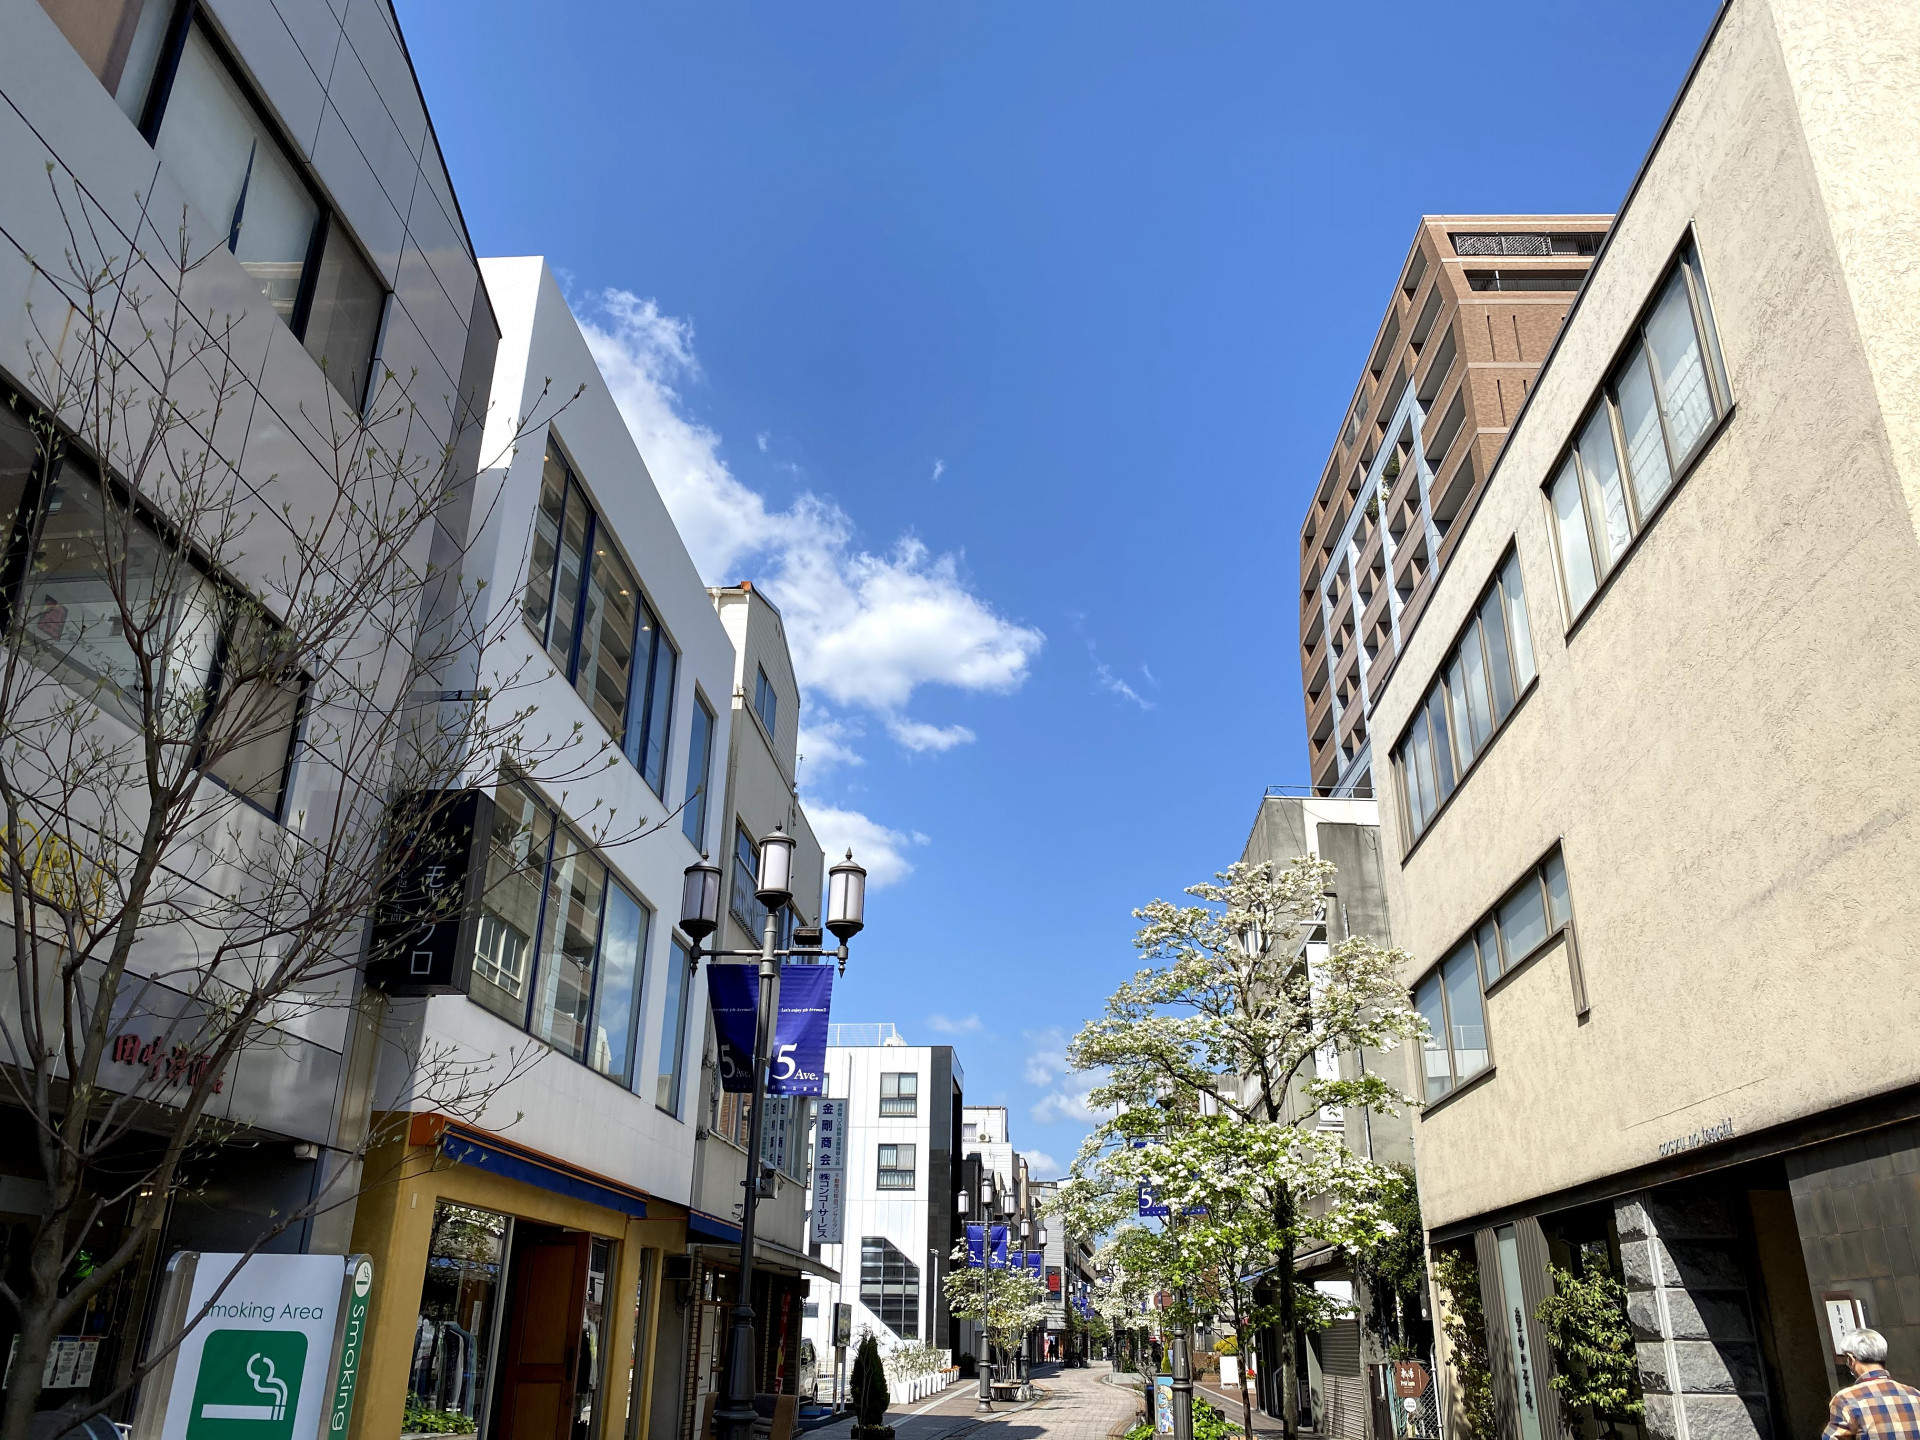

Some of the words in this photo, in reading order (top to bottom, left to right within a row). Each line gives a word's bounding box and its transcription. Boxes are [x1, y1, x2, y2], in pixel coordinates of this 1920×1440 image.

[720, 1043, 736, 1079] 5
[772, 1043, 798, 1080] 5
[794, 1068, 819, 1080] Ave.
[820, 1102, 834, 1166] 金剛商会
[1141, 1187, 1152, 1208] 5
[969, 1250, 976, 1262] 5
[990, 1251, 998, 1264] 5
[280, 1303, 323, 1320] Area
[331, 1304, 365, 1431] Smoking
